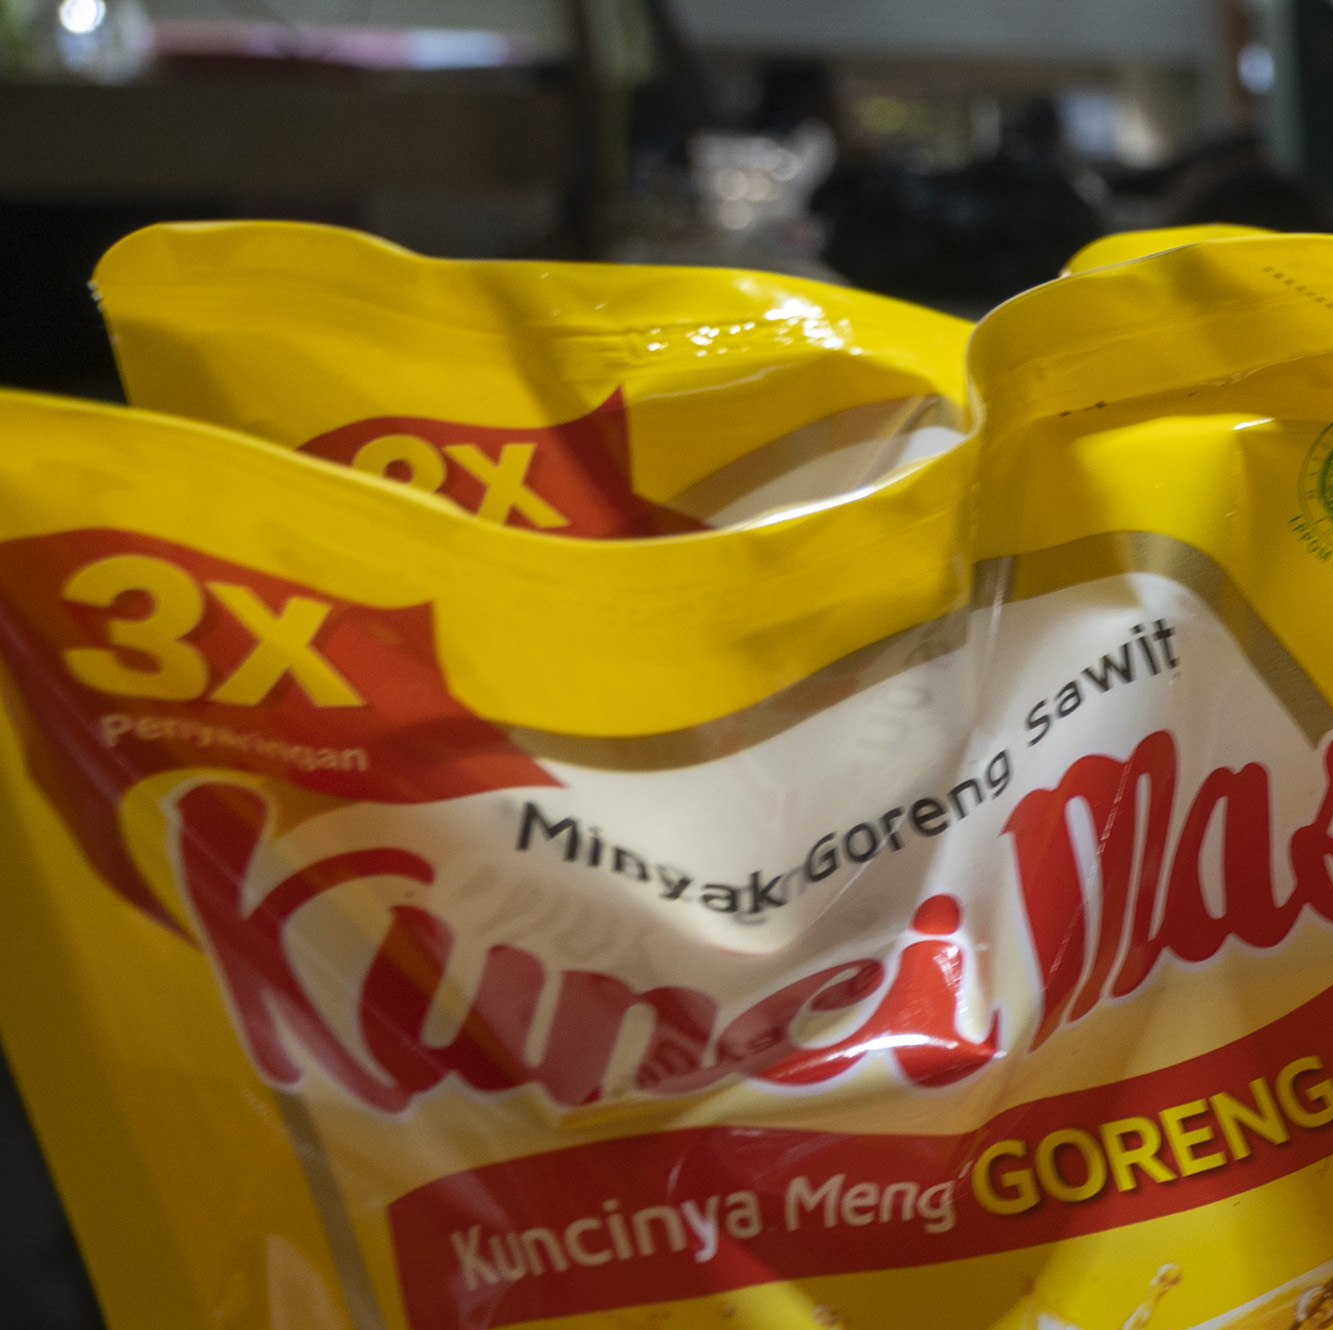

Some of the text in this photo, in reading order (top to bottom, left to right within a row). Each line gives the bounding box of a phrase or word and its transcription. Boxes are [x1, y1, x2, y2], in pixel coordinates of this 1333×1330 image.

[61, 553, 367, 708] 3X
[515, 801, 787, 914] Minyak
[804, 748, 1014, 882] Goreng
[172, 778, 1001, 1114] Kunci
[450, 1187, 763, 1290] Kuncinya
